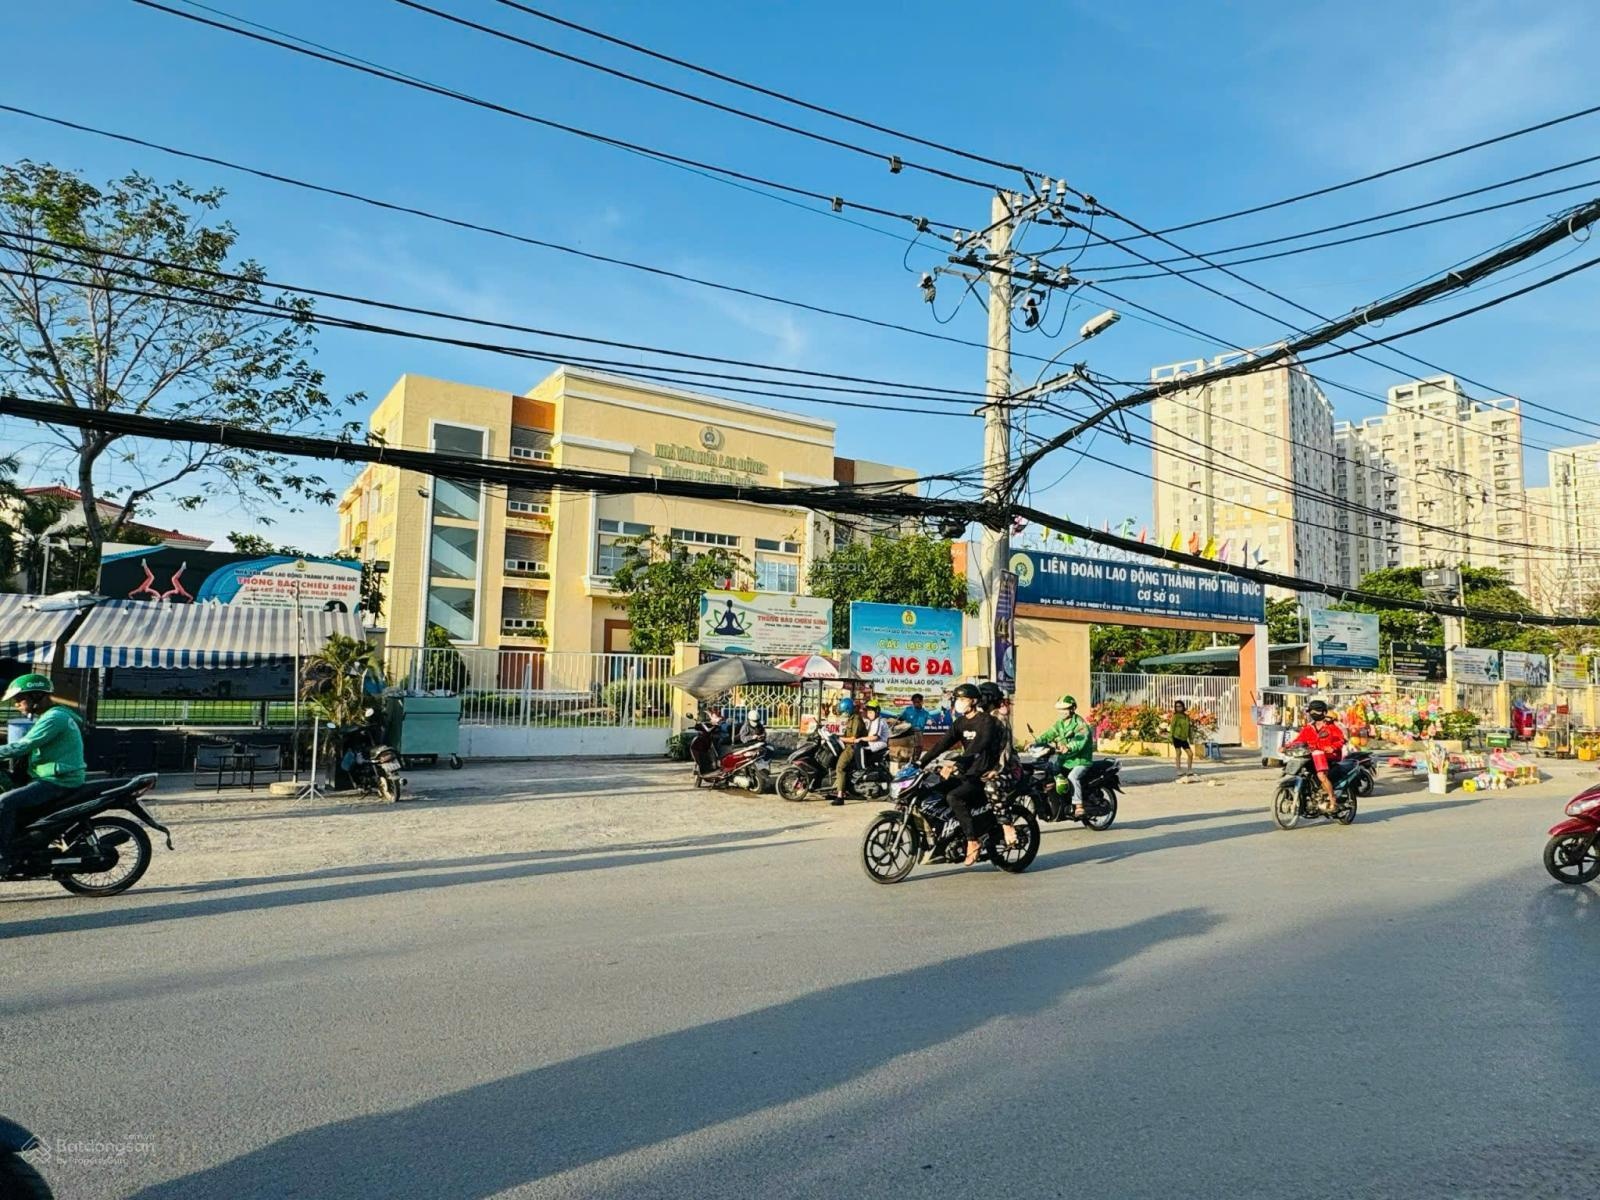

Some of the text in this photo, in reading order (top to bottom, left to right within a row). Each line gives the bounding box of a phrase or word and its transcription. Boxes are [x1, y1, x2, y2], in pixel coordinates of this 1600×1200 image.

[1040, 557, 1261, 596] LIÊN ĐOÀN LAO ĐỘNG THÀNH PHỐ THỦ ĐỨC
[332, 583, 356, 592] SINH
[1137, 588, 1180, 605] CƠ SỞ 01
